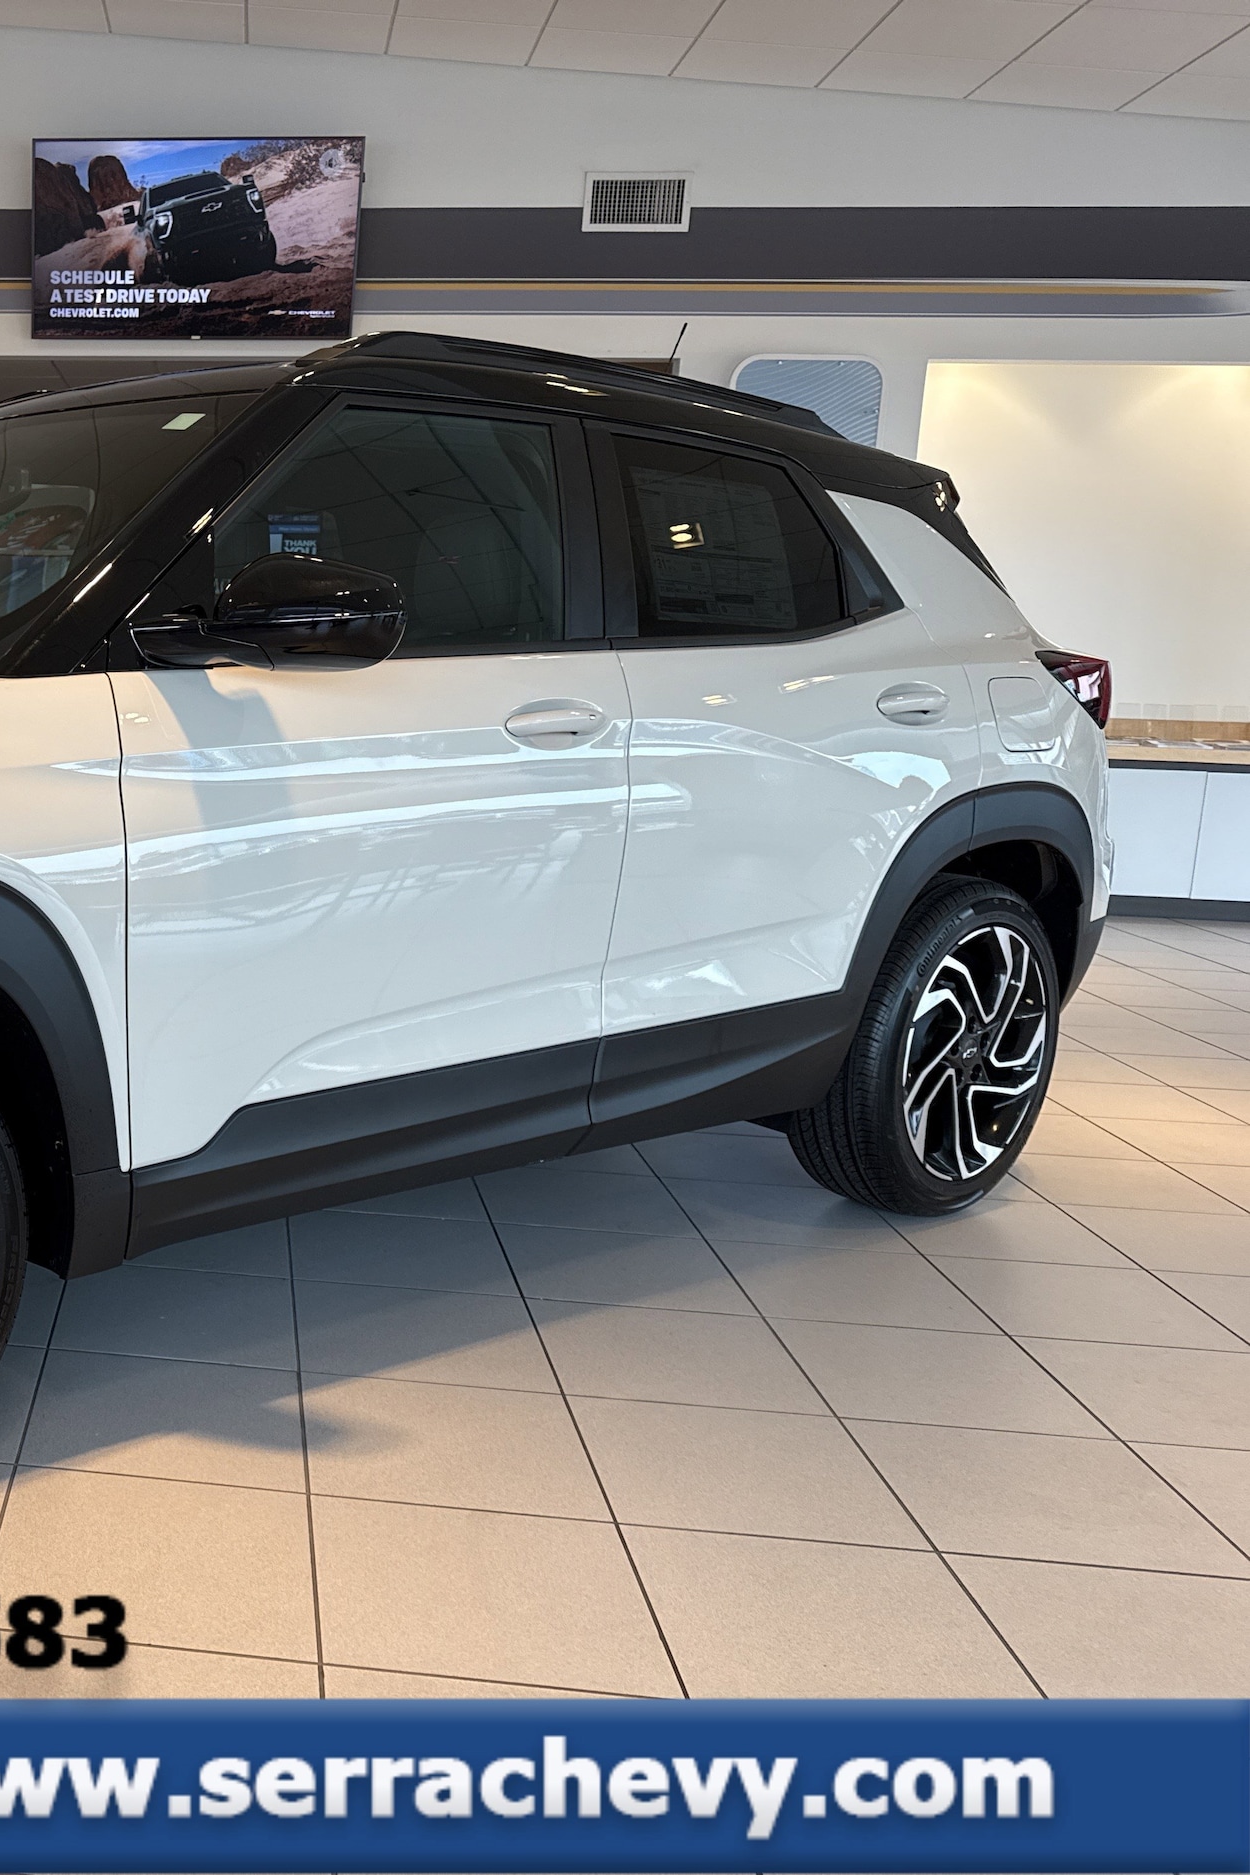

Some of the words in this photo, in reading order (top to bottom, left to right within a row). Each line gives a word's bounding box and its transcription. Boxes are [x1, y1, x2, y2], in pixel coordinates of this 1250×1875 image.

[49, 270, 135, 285] SCHEDULE
[50, 288, 63, 304] A
[64, 288, 105, 304] TEST
[106, 288, 155, 304] DRIVE
[155, 288, 212, 304] TODAY
[49, 307, 140, 319] CHEVROLET.COM
[283, 539, 317, 547] THANK
